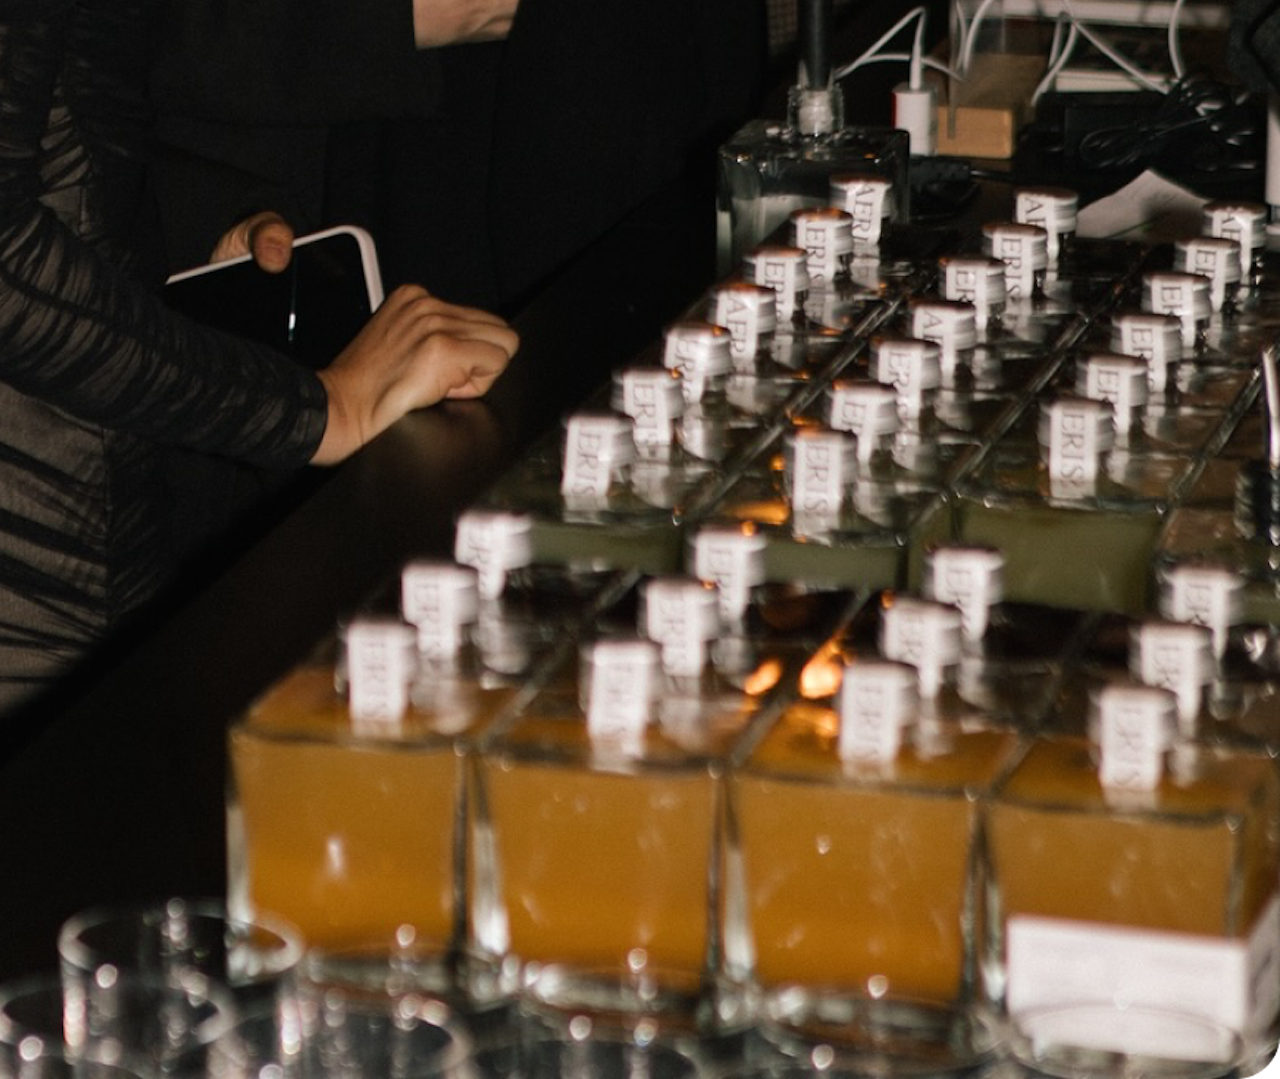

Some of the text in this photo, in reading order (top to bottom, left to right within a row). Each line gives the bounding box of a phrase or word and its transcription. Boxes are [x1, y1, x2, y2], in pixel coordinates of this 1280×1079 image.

[572, 431, 601, 496] ERIS
[1060, 412, 1085, 478] ERIS
[804, 445, 829, 518] ERIS
